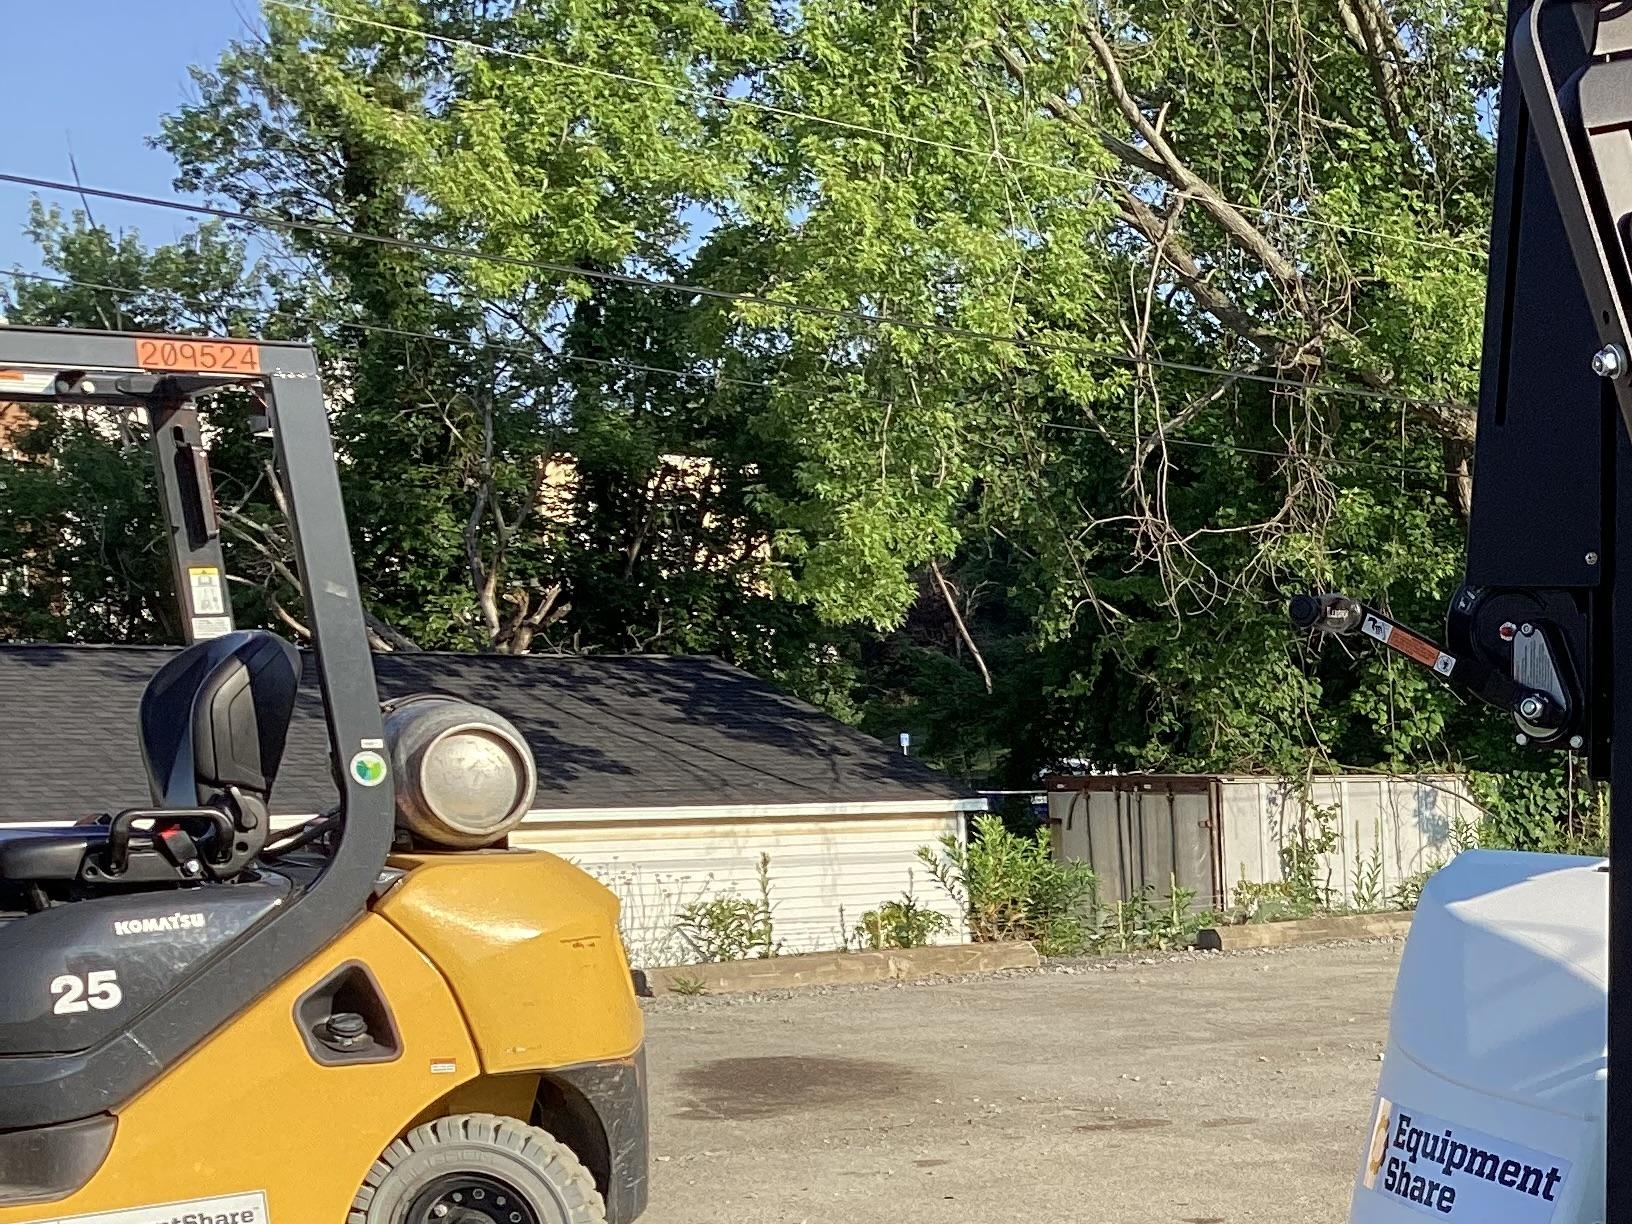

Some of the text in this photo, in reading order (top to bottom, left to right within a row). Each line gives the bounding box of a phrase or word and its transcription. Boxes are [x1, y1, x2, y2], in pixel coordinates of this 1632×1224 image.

[140, 340, 259, 371] 209524
[114, 912, 205, 936] KOMATSU
[50, 970, 122, 1015] 25
[1393, 1113, 1562, 1202] Equipment
[1384, 1156, 1456, 1214] Share
